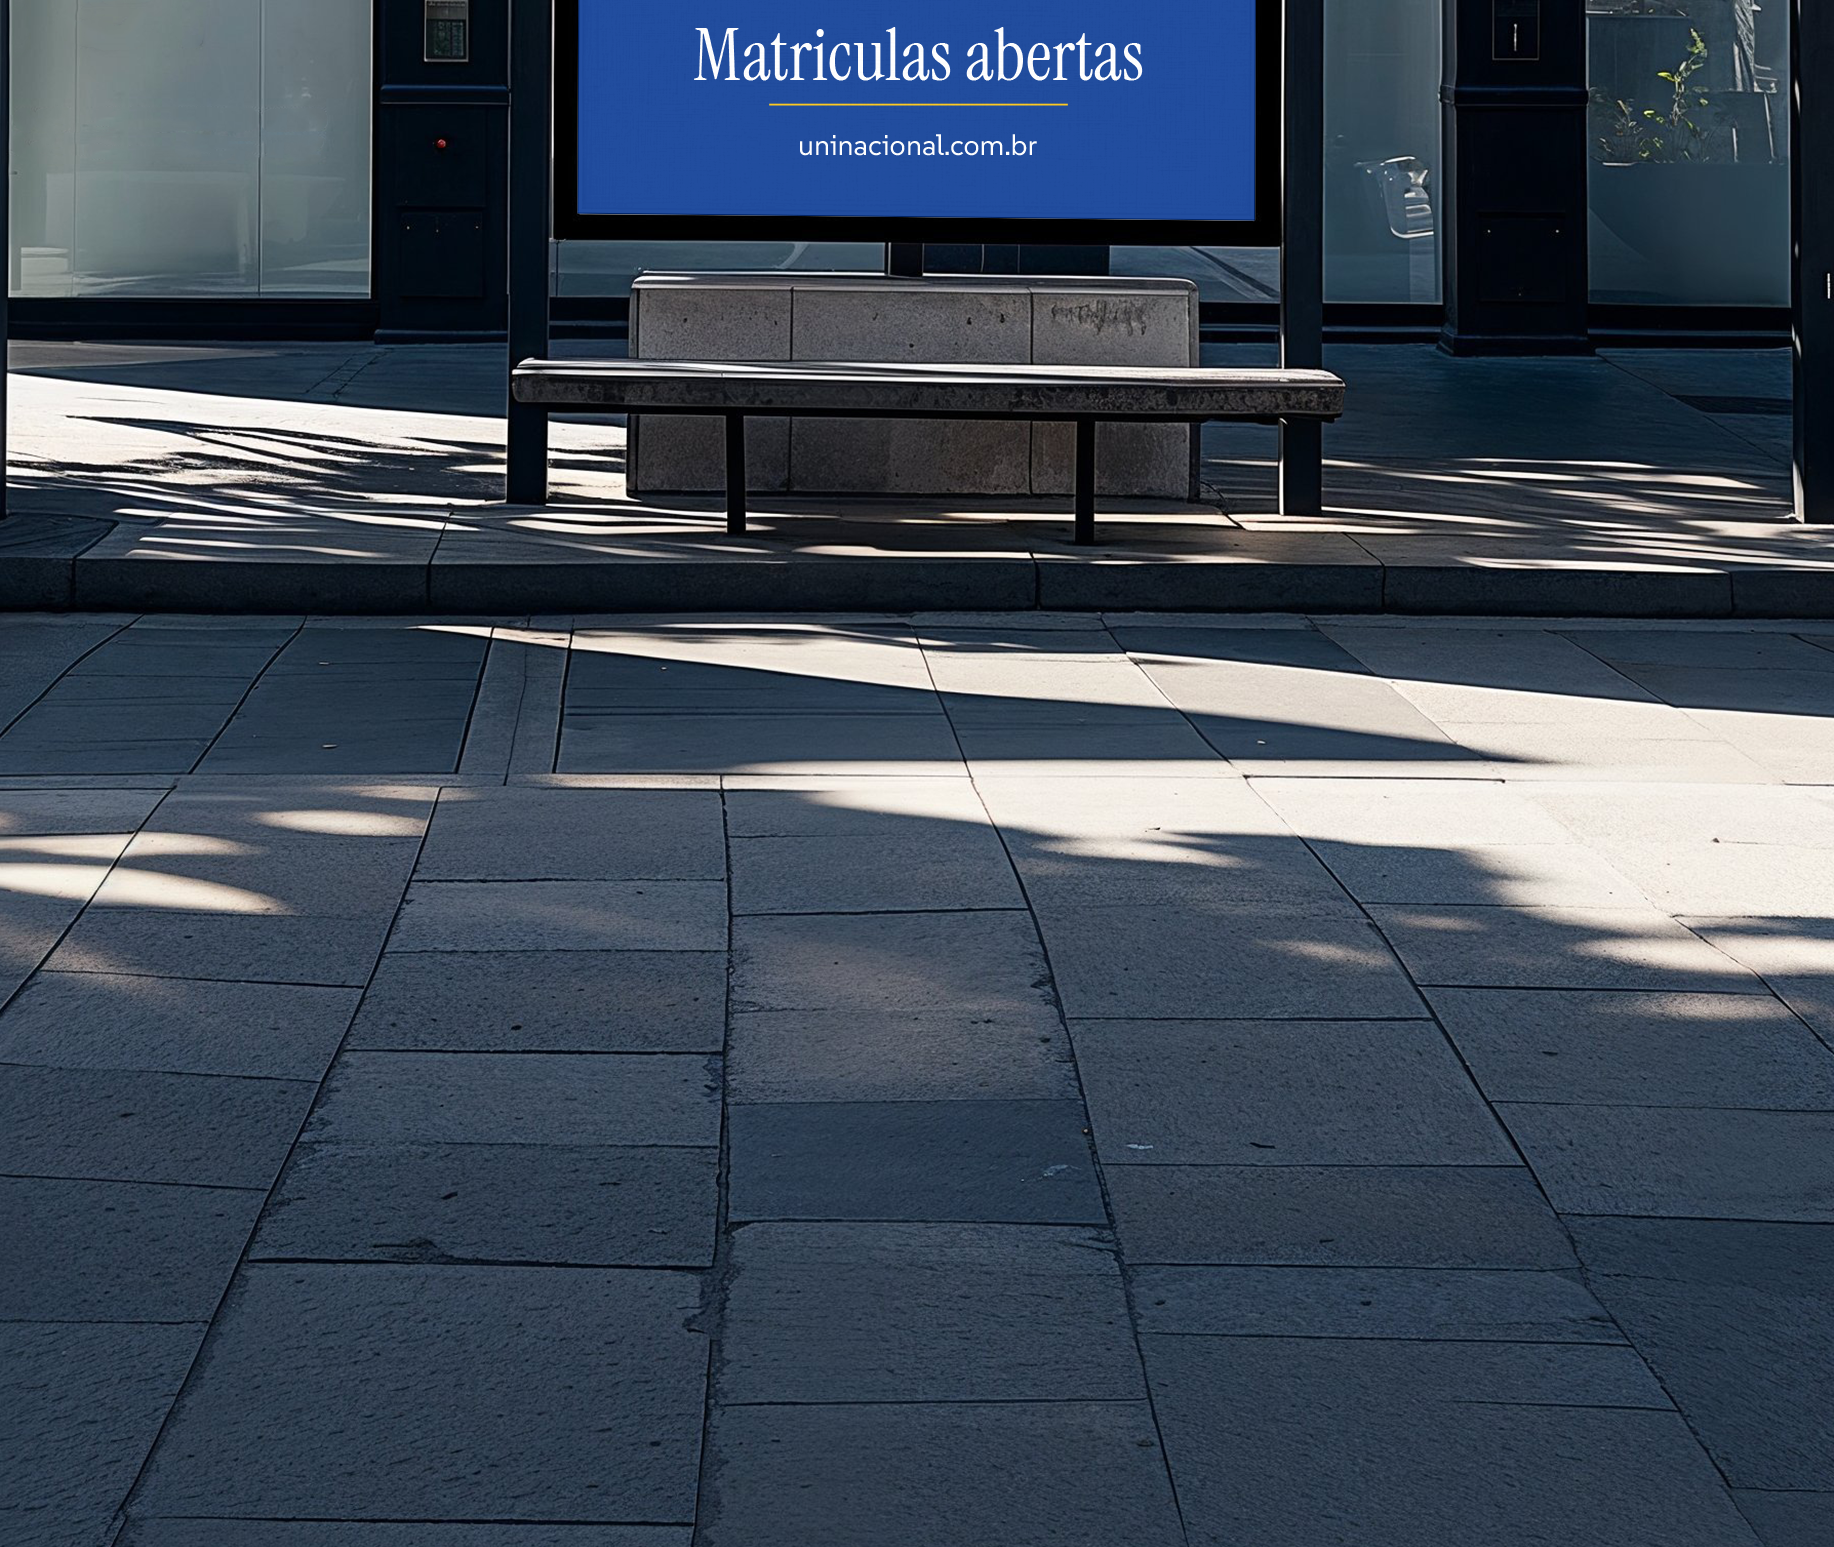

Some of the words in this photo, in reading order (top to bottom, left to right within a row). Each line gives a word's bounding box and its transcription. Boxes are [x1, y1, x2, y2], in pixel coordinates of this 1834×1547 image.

[693, 26, 951, 81] Matriculas
[966, 26, 1143, 81] abertas
[799, 133, 1038, 156] uninacional.com.br
